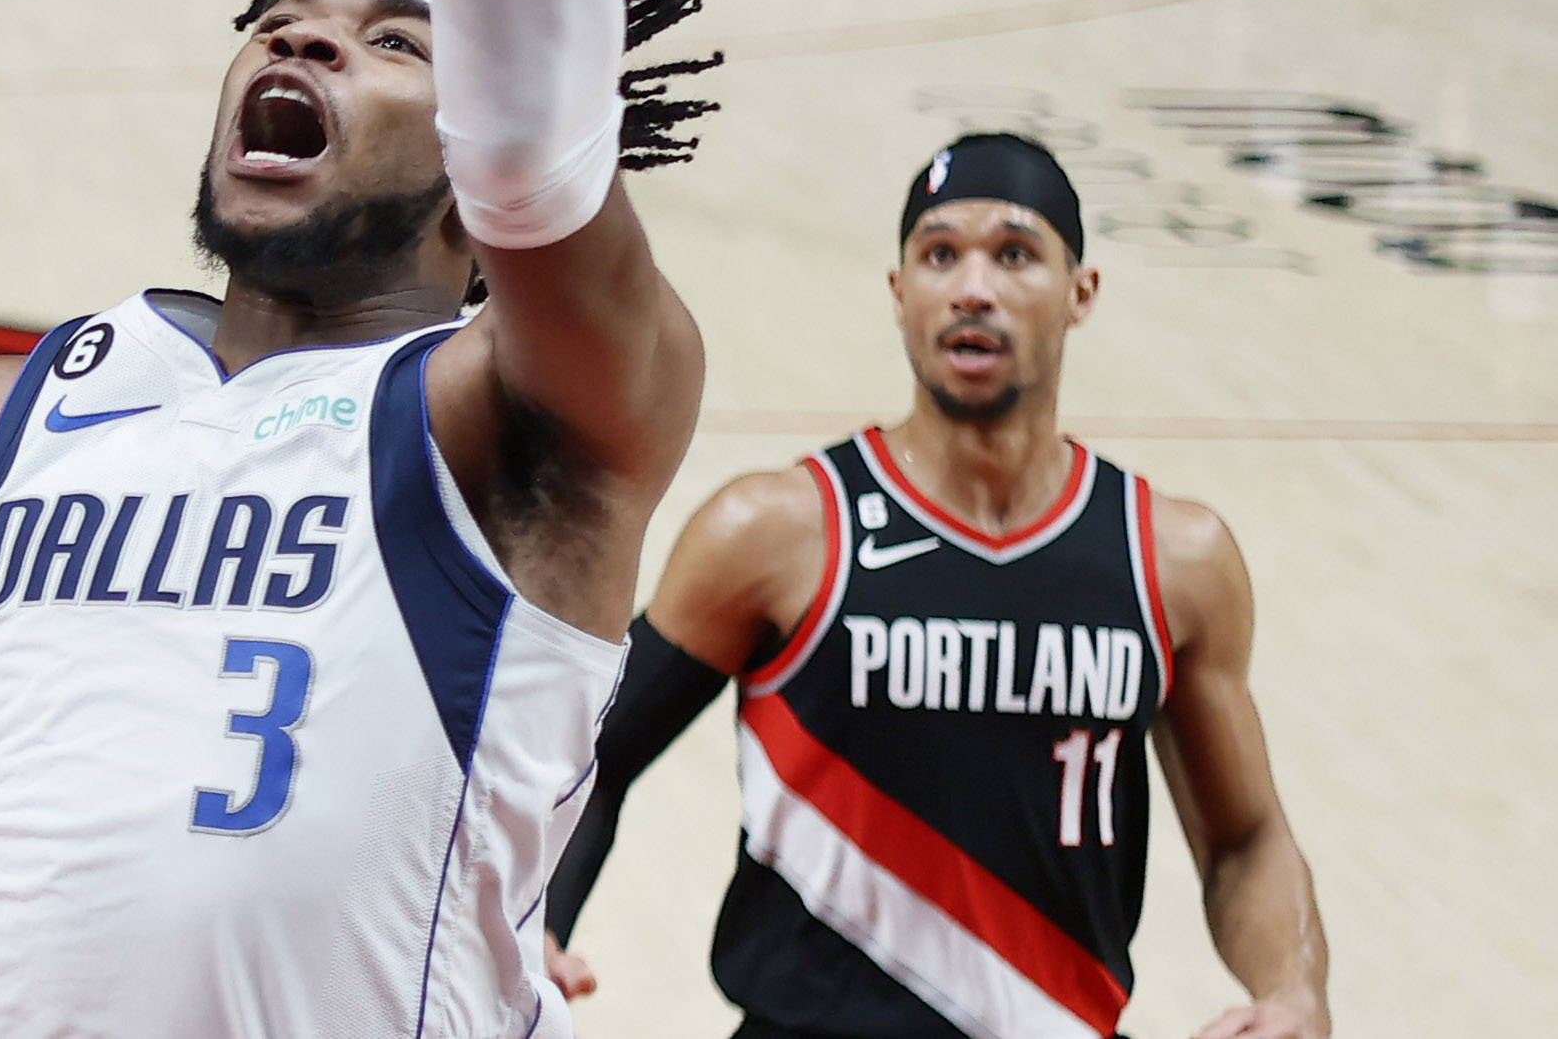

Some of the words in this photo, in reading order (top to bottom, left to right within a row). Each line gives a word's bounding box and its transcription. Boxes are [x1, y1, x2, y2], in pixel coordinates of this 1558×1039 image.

[61, 329, 105, 374] 6
[254, 394, 357, 440] chime
[842, 614, 1144, 722] PORTLAND
[187, 634, 317, 838] 3
[1051, 727, 1124, 848] 11
